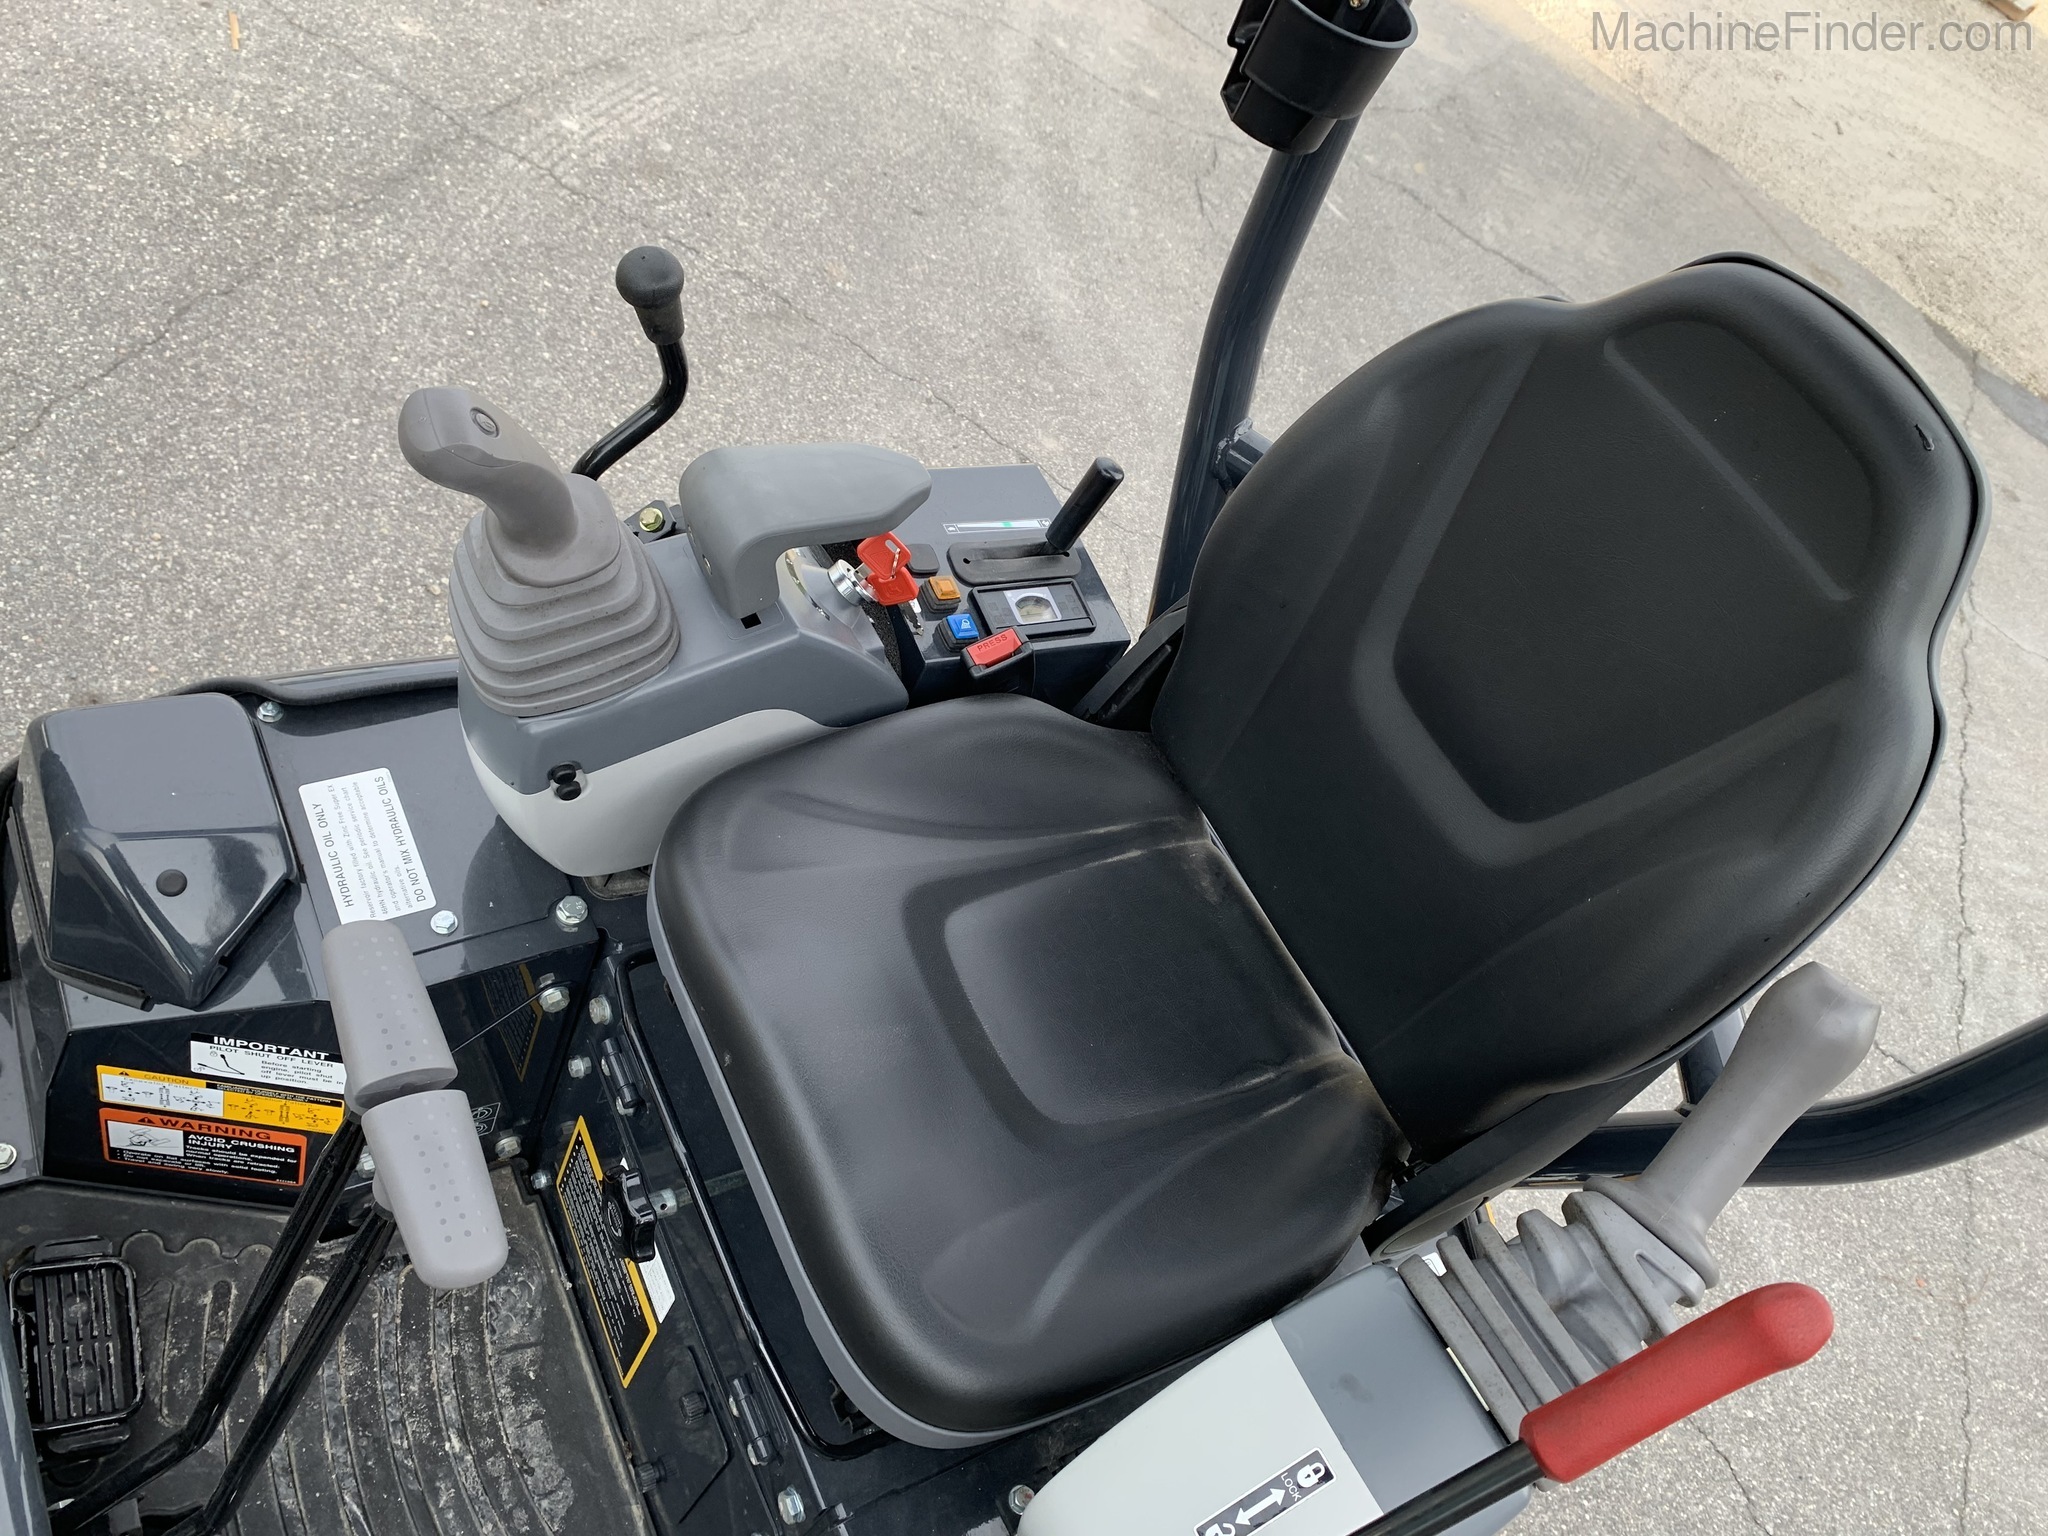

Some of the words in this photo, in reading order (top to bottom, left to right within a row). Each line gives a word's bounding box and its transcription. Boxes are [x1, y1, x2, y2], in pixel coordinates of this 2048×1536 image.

[977, 634, 1007, 652] PRESS
[341, 787, 350, 801] chart
[374, 776, 388, 795] OILS
[332, 794, 340, 810] Super
[352, 782, 366, 810] acceptable
[312, 802, 328, 828] ONLY
[347, 803, 358, 822] service
[363, 812, 376, 838] determine
[382, 798, 407, 846] HYDRAULIC
[322, 831, 334, 848] OIL
[342, 826, 350, 837] Zinc
[354, 824, 367, 846] periodic
[346, 839, 354, 850] with
[350, 853, 359, 867] filled
[374, 848, 386, 868] manual
[400, 850, 413, 864] MIX
[328, 850, 354, 907] HYDRAULIC
[357, 869, 367, 888] factory
[370, 871, 383, 897] hydraulic
[383, 870, 397, 898] operator's
[406, 868, 420, 886] NOT
[399, 879, 413, 908] alternative
[414, 888, 426, 902] DO
[363, 891, 376, 918] Reservoir
[392, 901, 401, 911] and
[210, 1045, 238, 1053] PILOT
[244, 1050, 271, 1058] SHUT
[302, 1059, 334, 1068] LEVER
[213, 1036, 329, 1060] IMPORTANT
[261, 1060, 287, 1068] Before
[292, 1065, 322, 1073] starting
[261, 1066, 290, 1074] engine,
[294, 1069, 313, 1077] pilot
[124, 1077, 164, 1086] Excavator
[144, 1074, 189, 1084] CAUTION
[159, 1118, 271, 1140] WARNING
[188, 1134, 226, 1144] AVOID
[230, 1140, 295, 1153] CRUSHING
[188, 1140, 232, 1150] INJURY
[213, 1153, 253, 1161] operations.
[250, 1154, 284, 1162] expanded
[251, 1166, 277, 1174] footing.
[1280, 1472, 1302, 1502] LOCK
